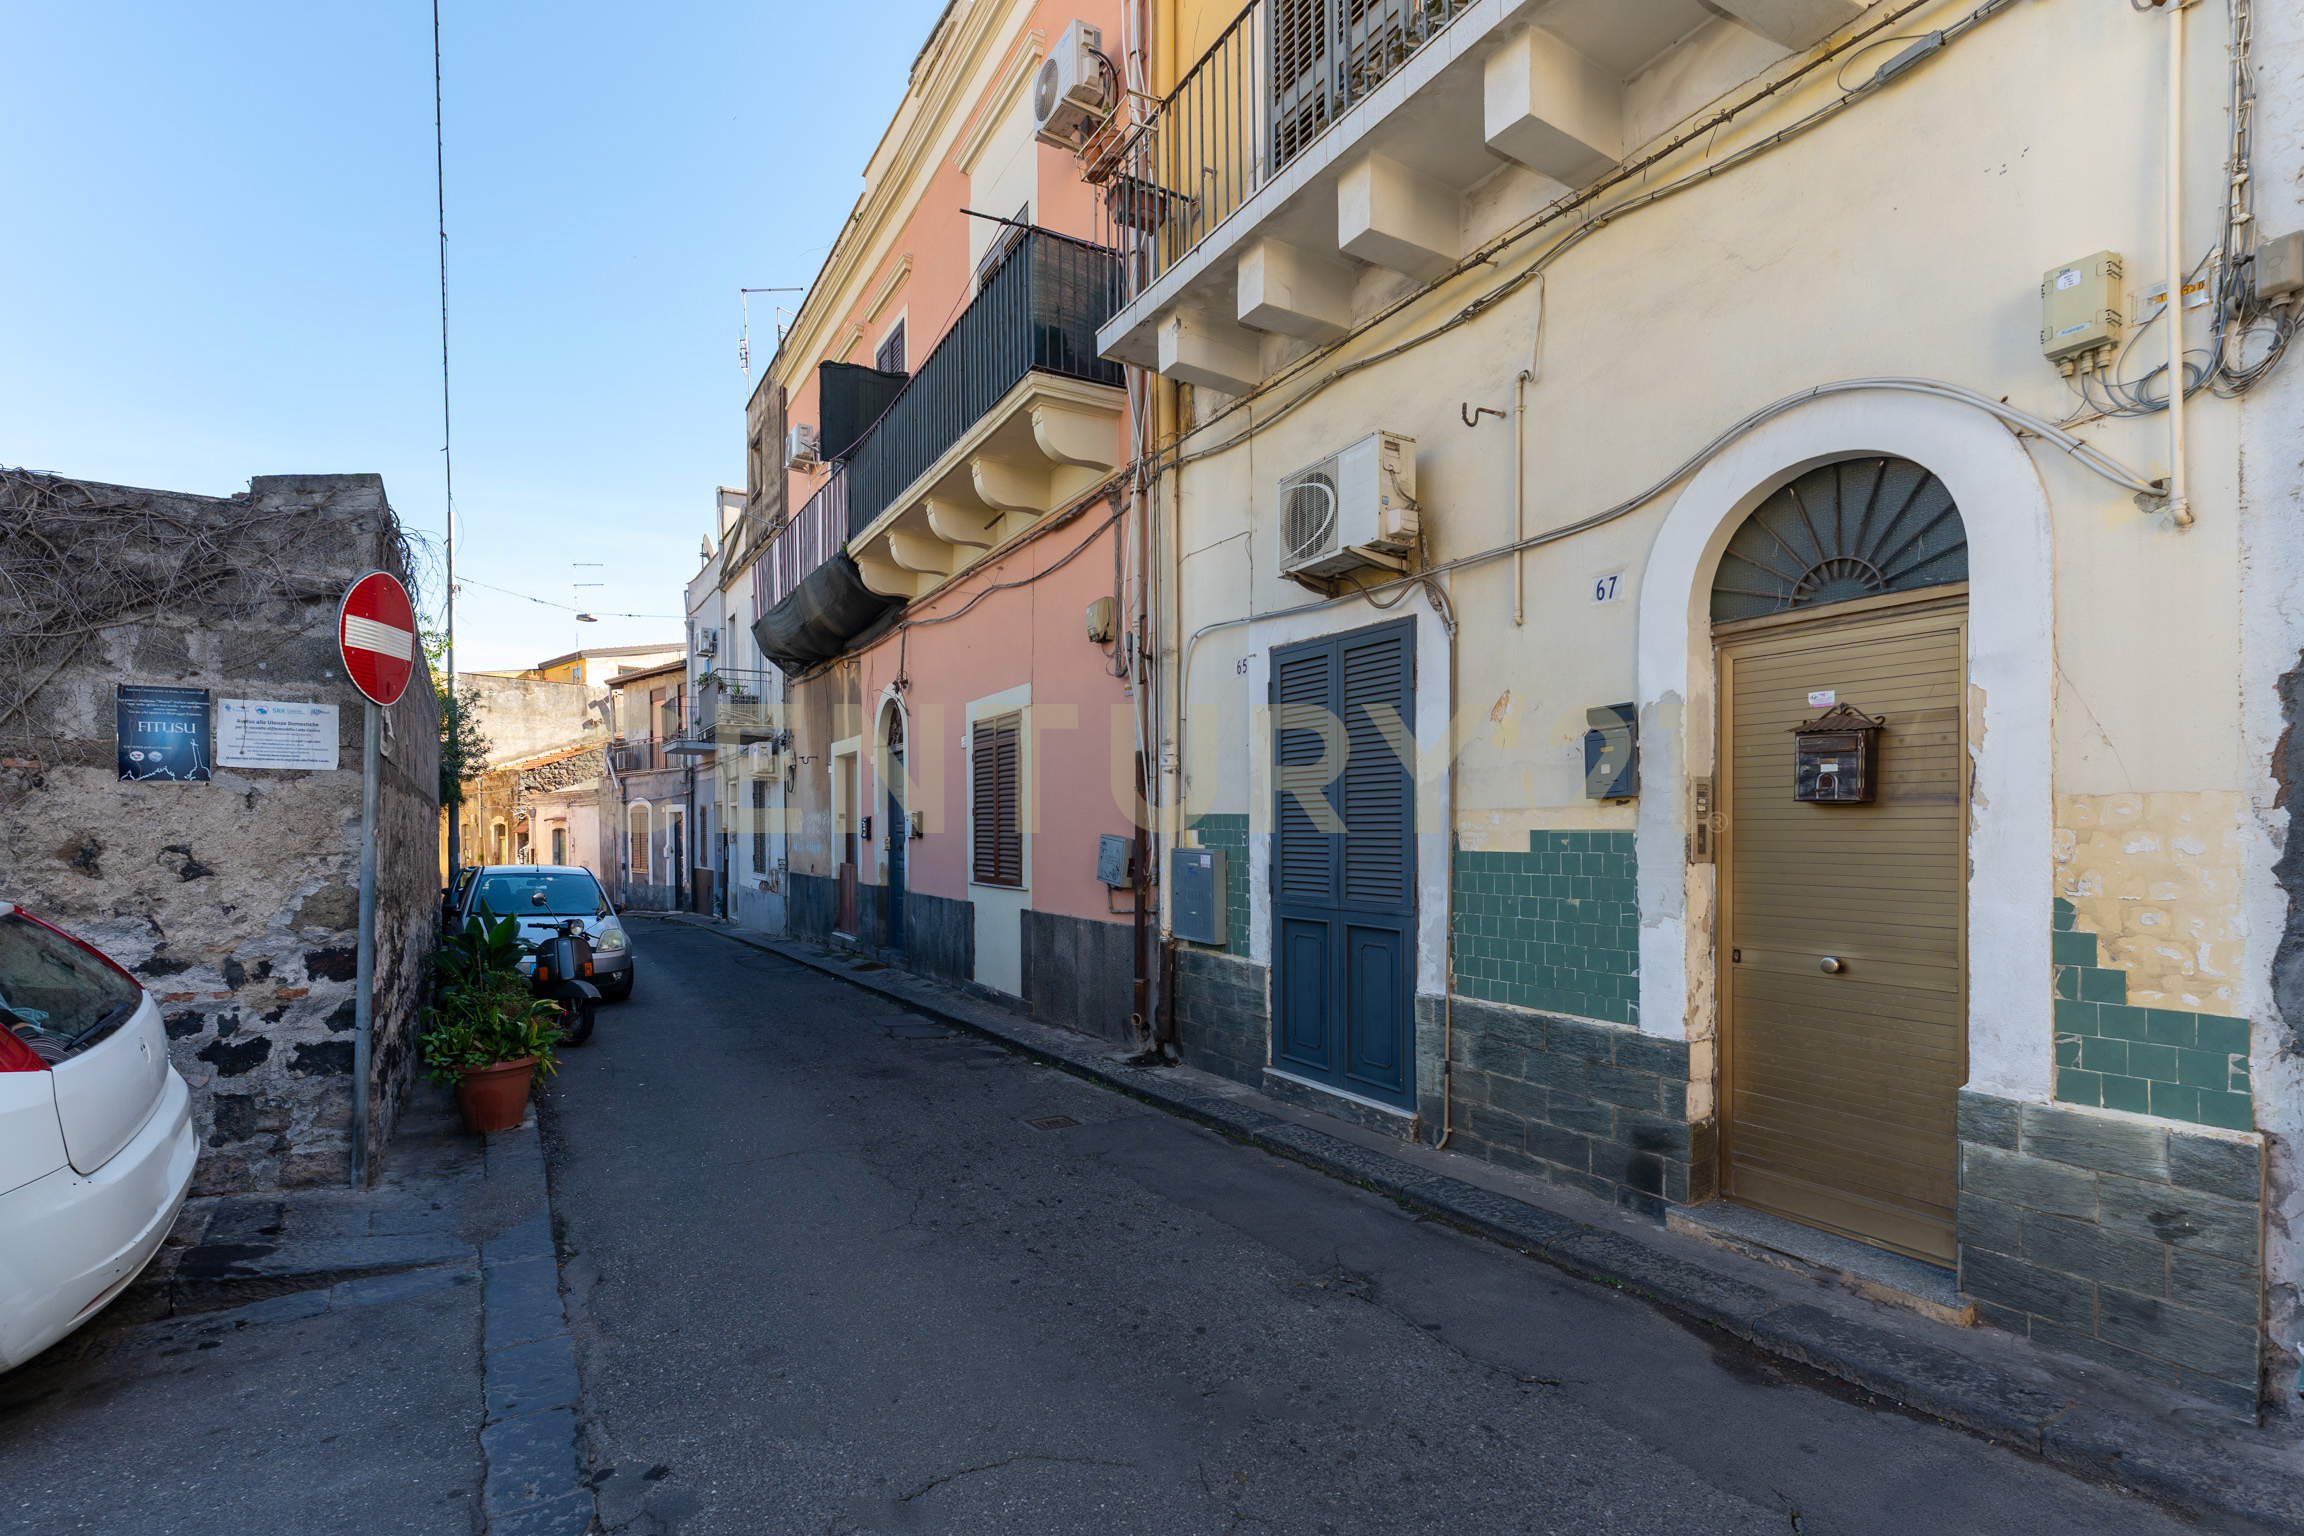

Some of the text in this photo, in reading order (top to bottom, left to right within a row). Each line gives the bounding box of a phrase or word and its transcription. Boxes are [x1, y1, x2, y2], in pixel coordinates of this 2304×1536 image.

[1597, 576, 1617, 600] 67
[1237, 659, 1248, 675] 65
[138, 721, 196, 734] FITUSU
